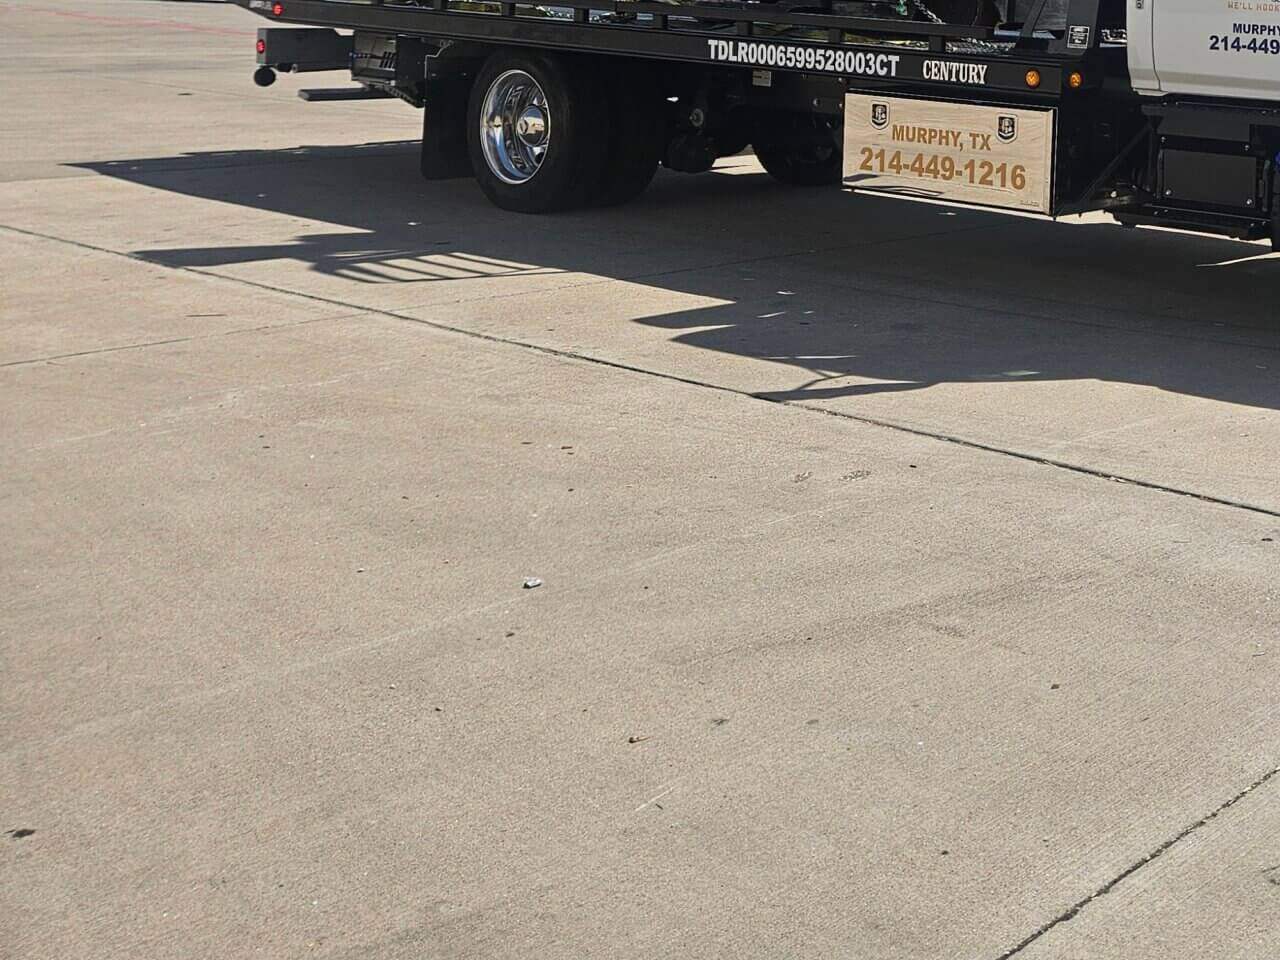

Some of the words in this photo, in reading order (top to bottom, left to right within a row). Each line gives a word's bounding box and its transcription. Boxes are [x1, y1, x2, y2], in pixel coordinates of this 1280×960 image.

[1227, 0, 1254, 11] WE'LL
[1256, 3, 1280, 13] HOOK
[707, 39, 900, 78] TDLR0006599528003CT
[922, 59, 989, 85] CENTURY
[891, 124, 964, 152] MURPHY,
[968, 132, 993, 152] TX
[858, 146, 1027, 191] 214-449-1216
